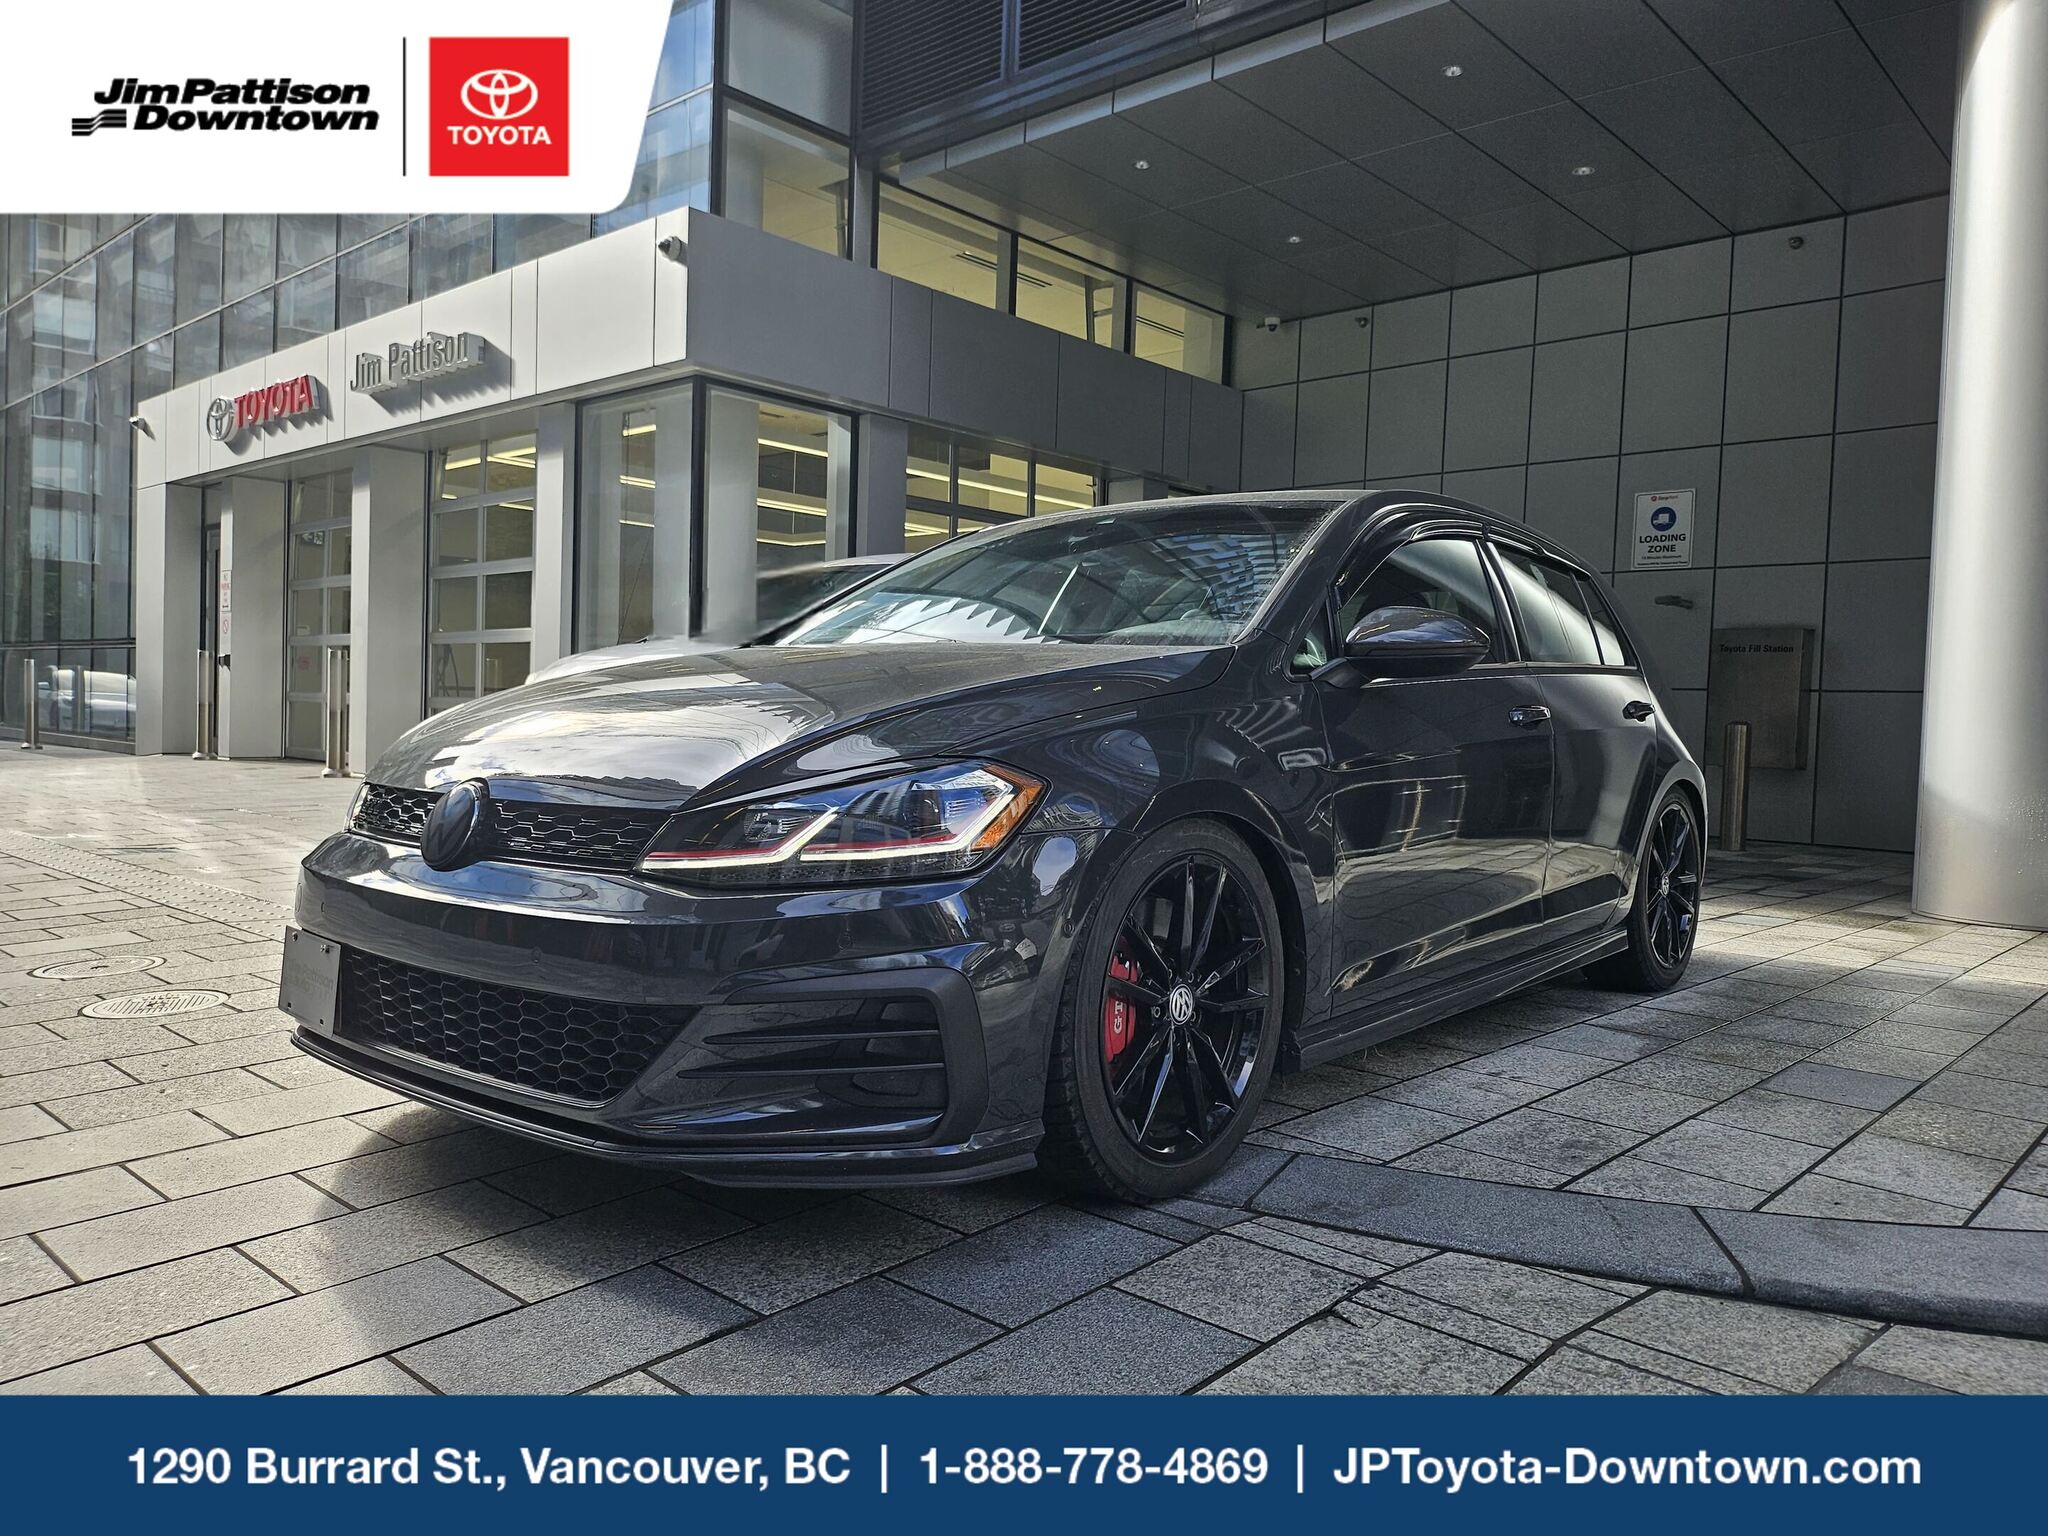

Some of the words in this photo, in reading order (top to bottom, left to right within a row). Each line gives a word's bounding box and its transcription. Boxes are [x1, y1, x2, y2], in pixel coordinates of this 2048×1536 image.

[234, 374, 314, 429] TOYOTA
[350, 352, 382, 391] Jim
[388, 331, 468, 380] Pattison
[1639, 533, 1686, 544] LOADING
[1647, 544, 1676, 553] ZONE
[1720, 643, 1746, 654] Toyota
[1748, 643, 1761, 653] Fill
[1762, 643, 1794, 653] Station
